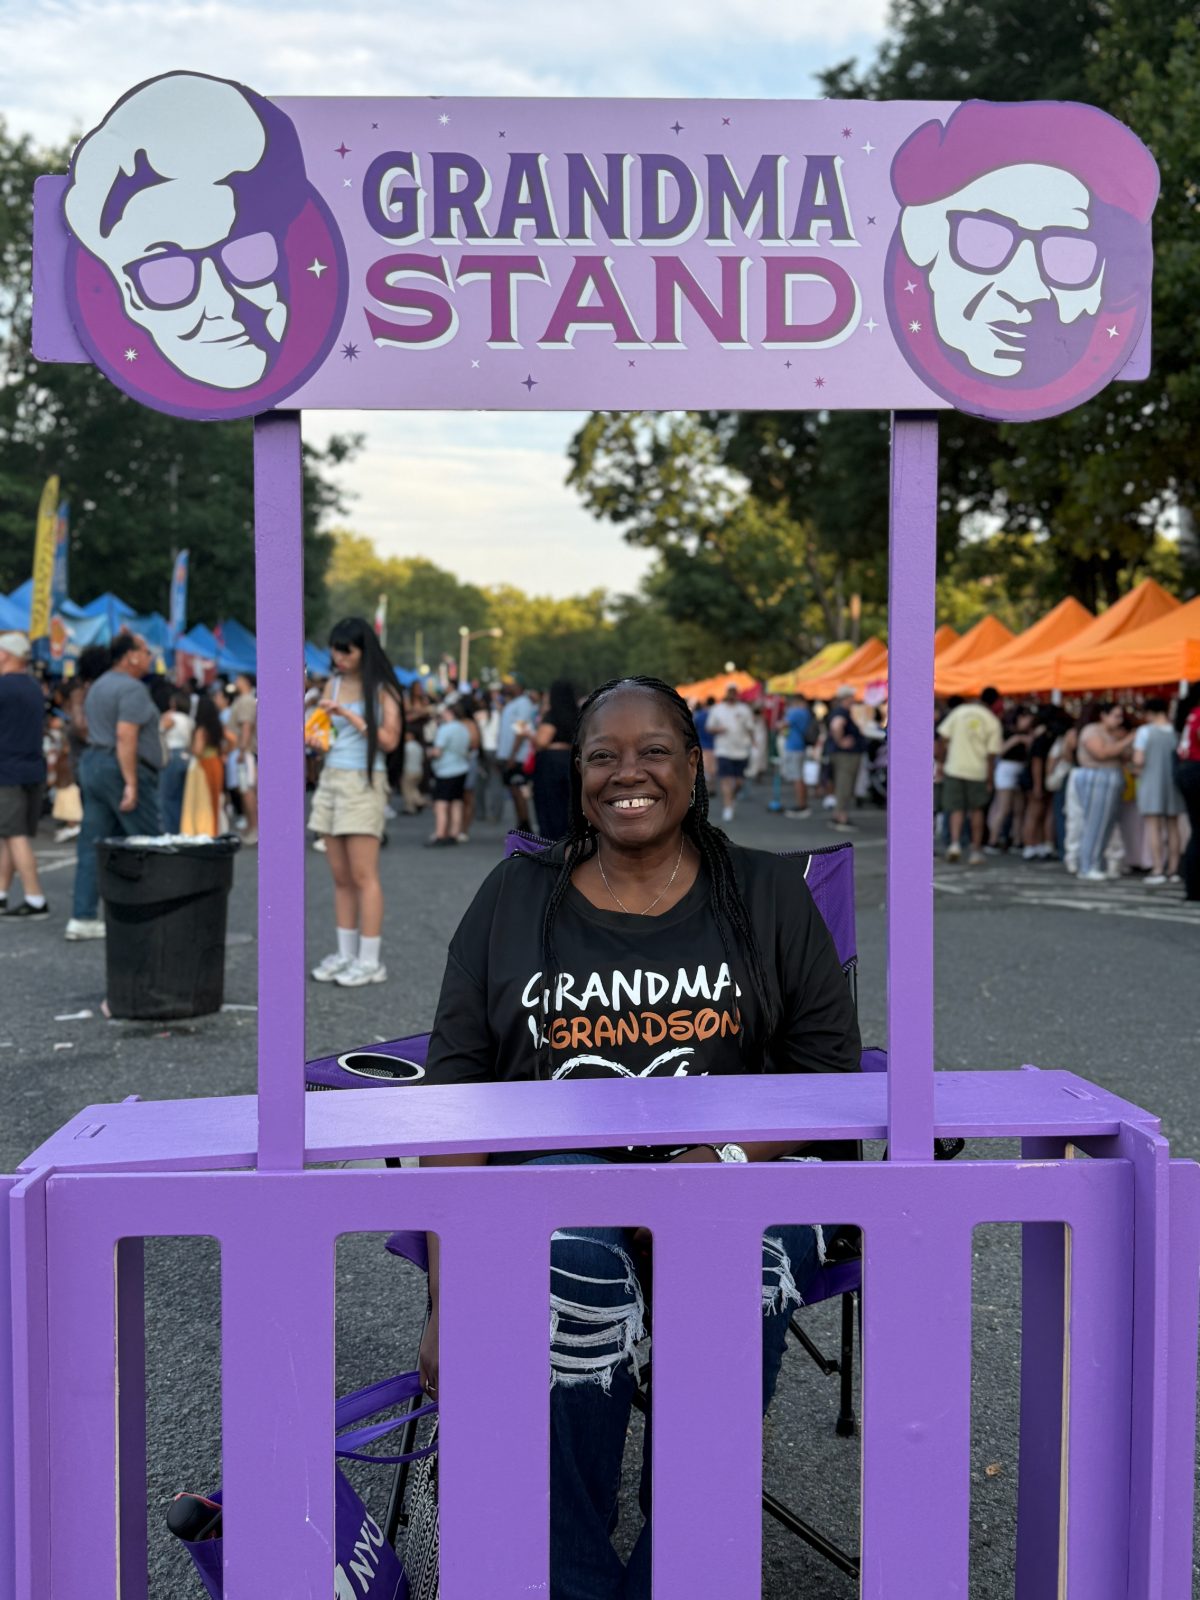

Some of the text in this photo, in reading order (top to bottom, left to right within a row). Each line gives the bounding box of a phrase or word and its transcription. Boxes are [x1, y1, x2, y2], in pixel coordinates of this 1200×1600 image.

[362, 150, 862, 247] GRANDMA
[363, 252, 863, 351] STAND
[521, 962, 742, 1015] GRANDMA
[549, 1007, 741, 1050] GRANDSON
